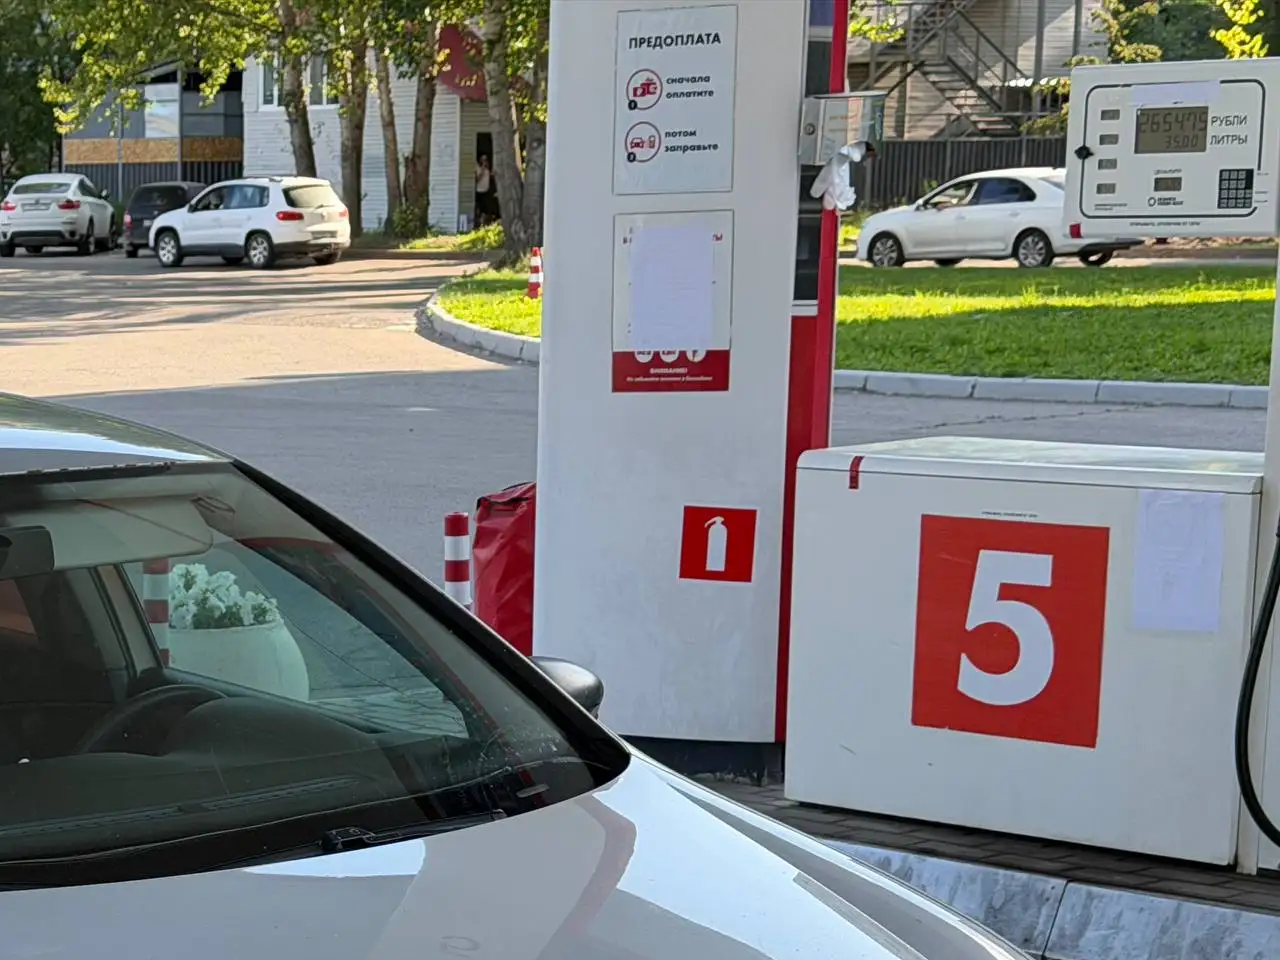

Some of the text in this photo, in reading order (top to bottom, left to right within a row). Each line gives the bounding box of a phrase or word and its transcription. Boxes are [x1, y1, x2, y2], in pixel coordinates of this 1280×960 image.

[628, 32, 722, 50] ПРЕДОПЛАТА
[666, 75, 711, 86] сначала
[666, 88, 714, 100] оплатите
[1211, 115, 1248, 128] РУБЛИ
[664, 128, 697, 139] потом
[1209, 134, 1248, 146] ЛИТРЫ
[664, 141, 719, 155] заправьте
[956, 549, 1054, 706] 5
